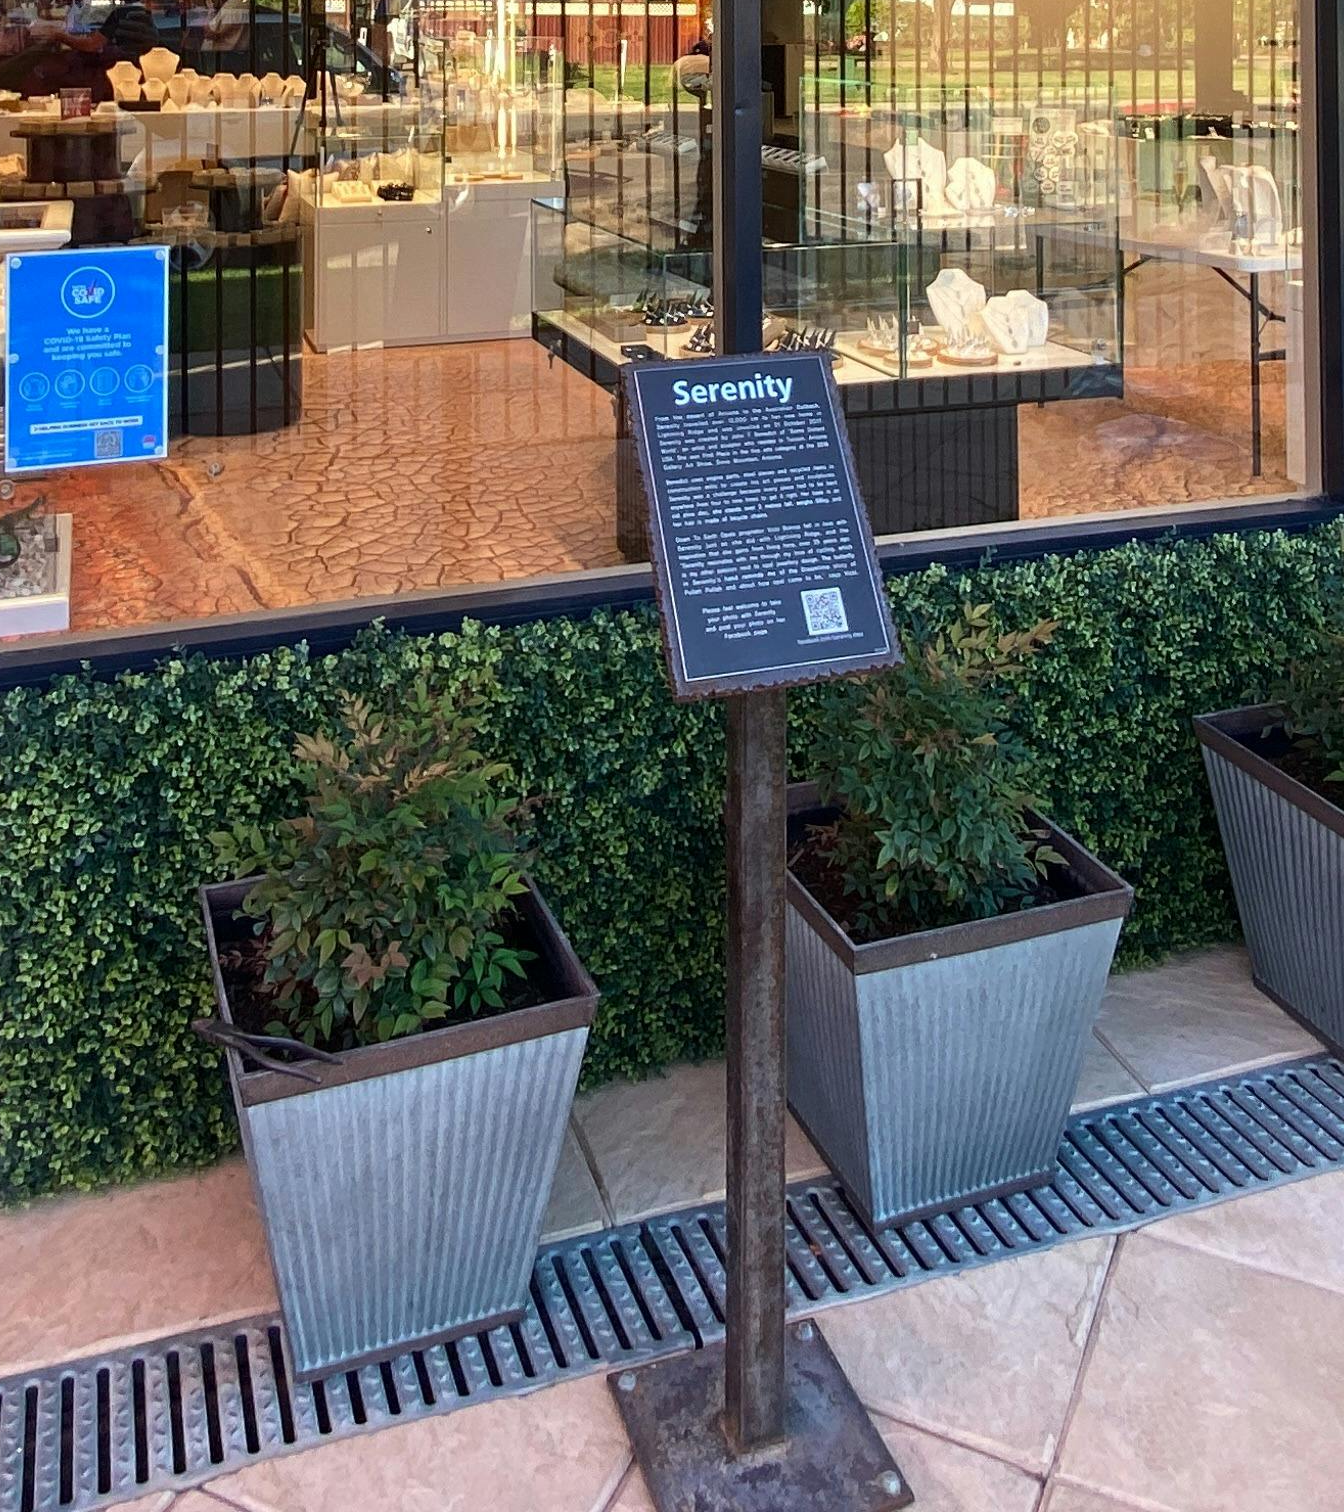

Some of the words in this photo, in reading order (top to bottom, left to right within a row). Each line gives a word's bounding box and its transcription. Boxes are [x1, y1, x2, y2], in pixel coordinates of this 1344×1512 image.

[74, 296, 102, 305] SAFE
[86, 334, 112, 343] Safety
[87, 351, 103, 360] you
[673, 373, 793, 406] Serenity
